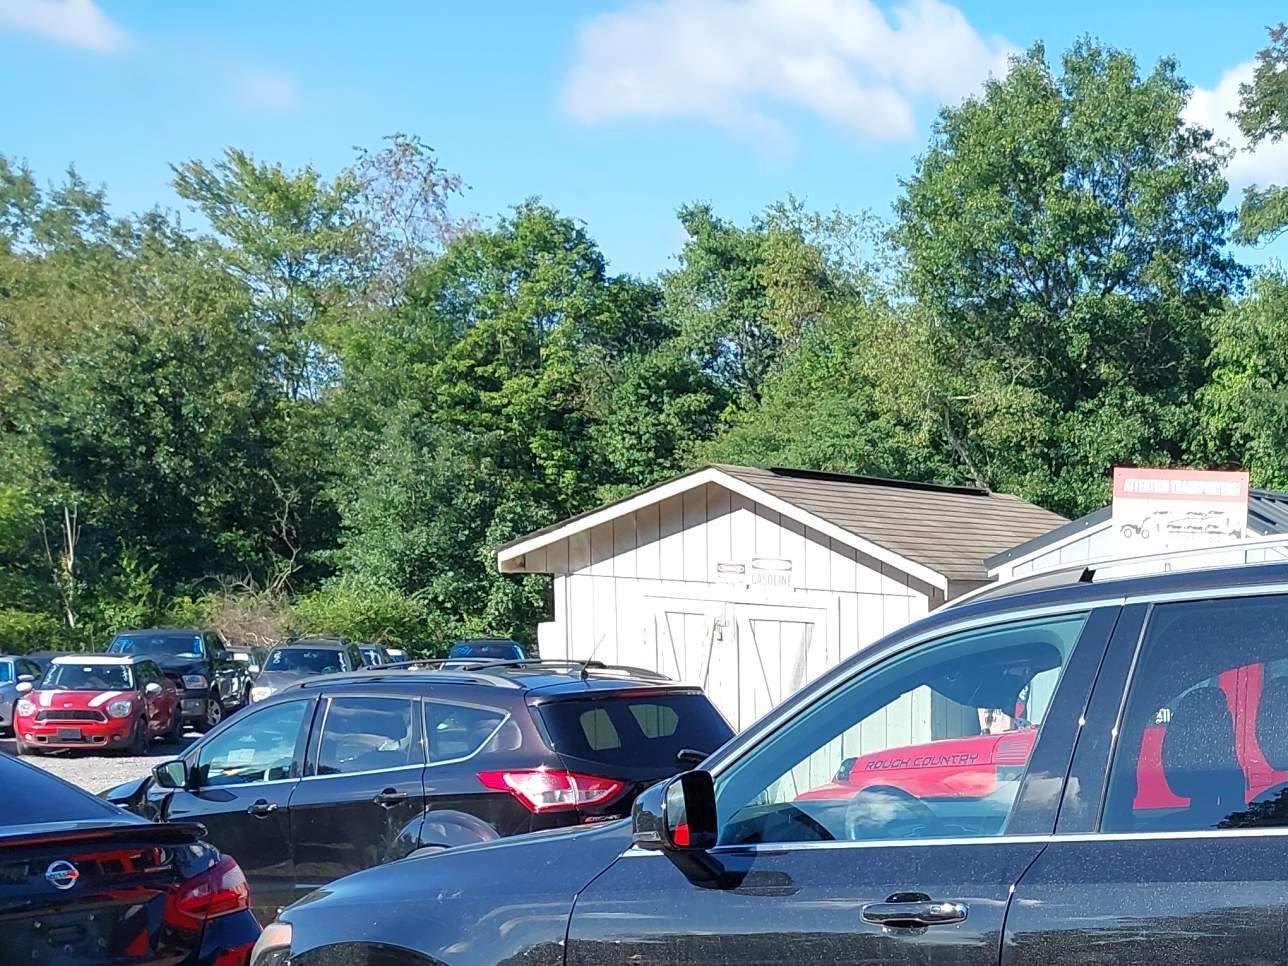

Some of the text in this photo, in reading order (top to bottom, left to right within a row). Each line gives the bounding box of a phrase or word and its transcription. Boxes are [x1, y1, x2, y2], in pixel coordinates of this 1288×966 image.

[751, 573, 792, 588] GASOLINE
[865, 752, 979, 770] ROUGH COUNTRY
